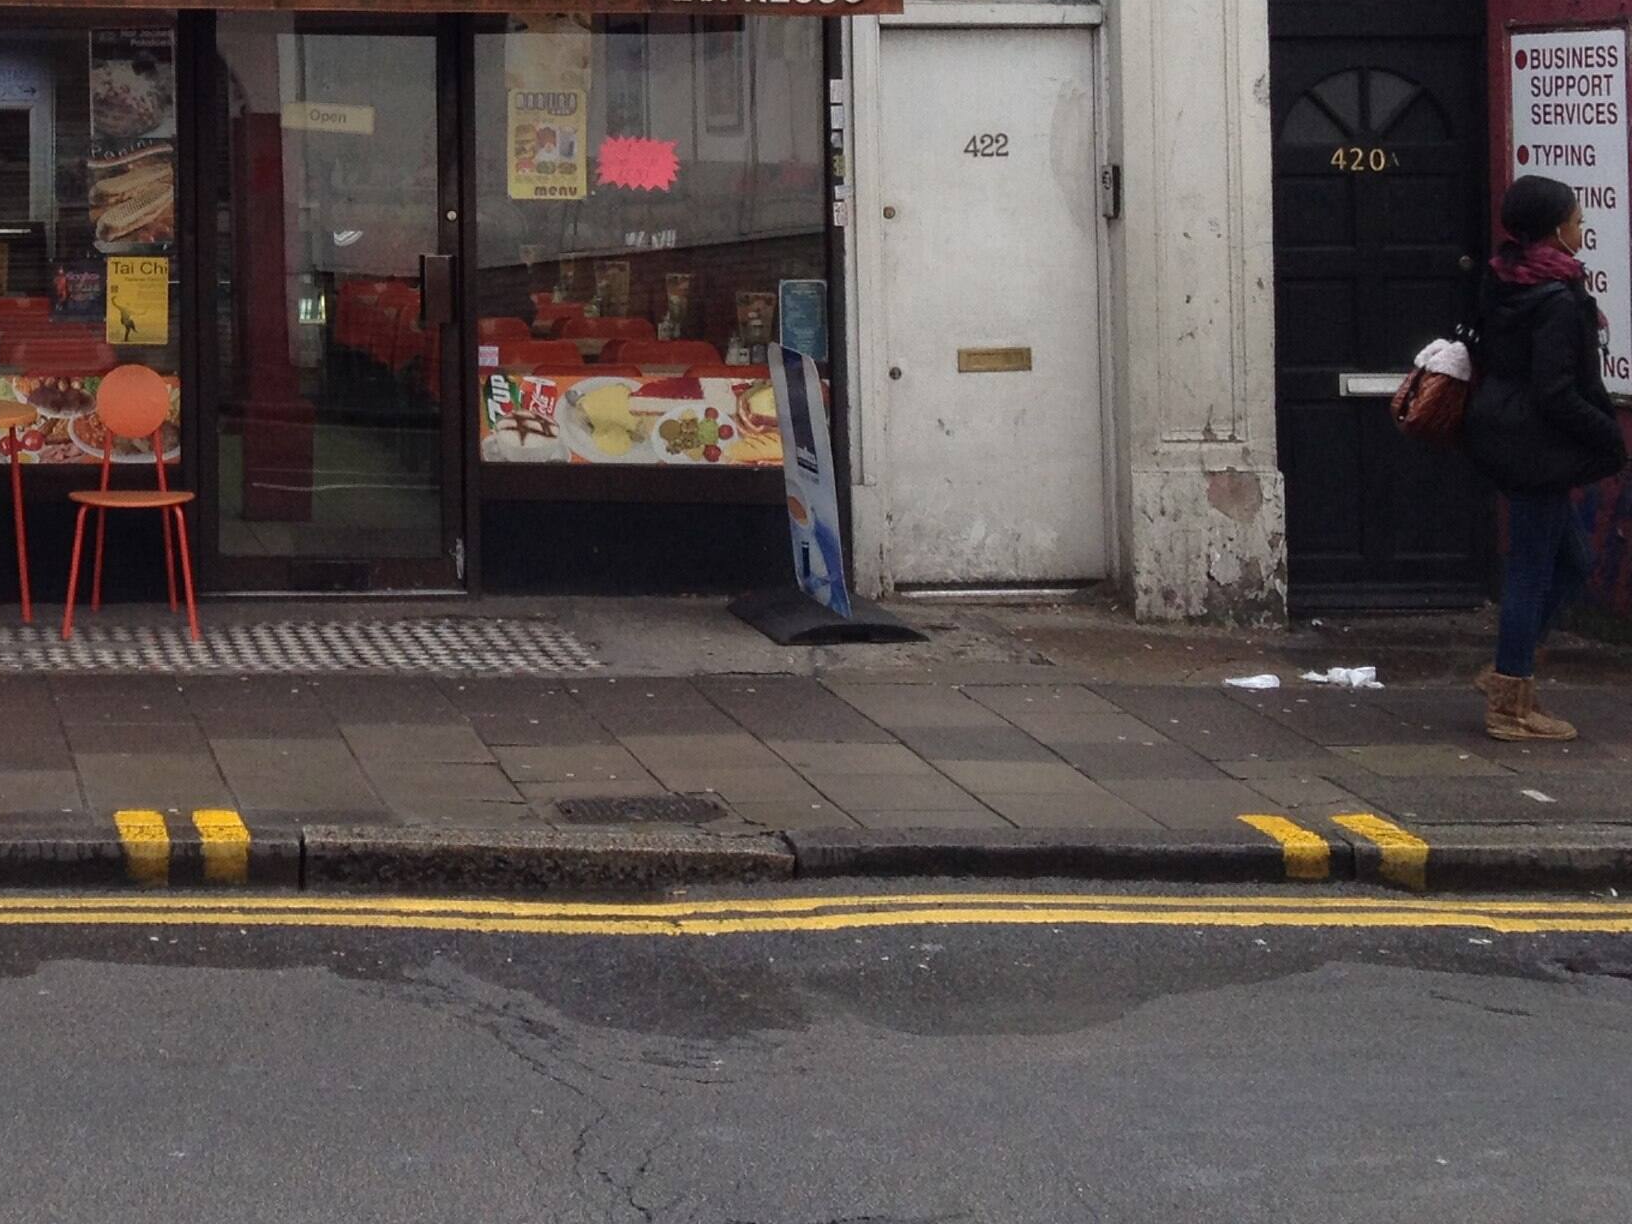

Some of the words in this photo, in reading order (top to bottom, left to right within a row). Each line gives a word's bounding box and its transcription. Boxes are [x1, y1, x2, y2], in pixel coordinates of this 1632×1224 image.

[1530, 46, 1618, 70] BUSINESS
[1530, 74, 1614, 97] SUPPORT
[310, 108, 347, 124] Open
[1530, 102, 1618, 126] SERVICES
[963, 132, 1009, 157] 422
[1532, 144, 1596, 167] TYPING
[534, 185, 578, 197] menu
[111, 261, 134, 274] Tai
